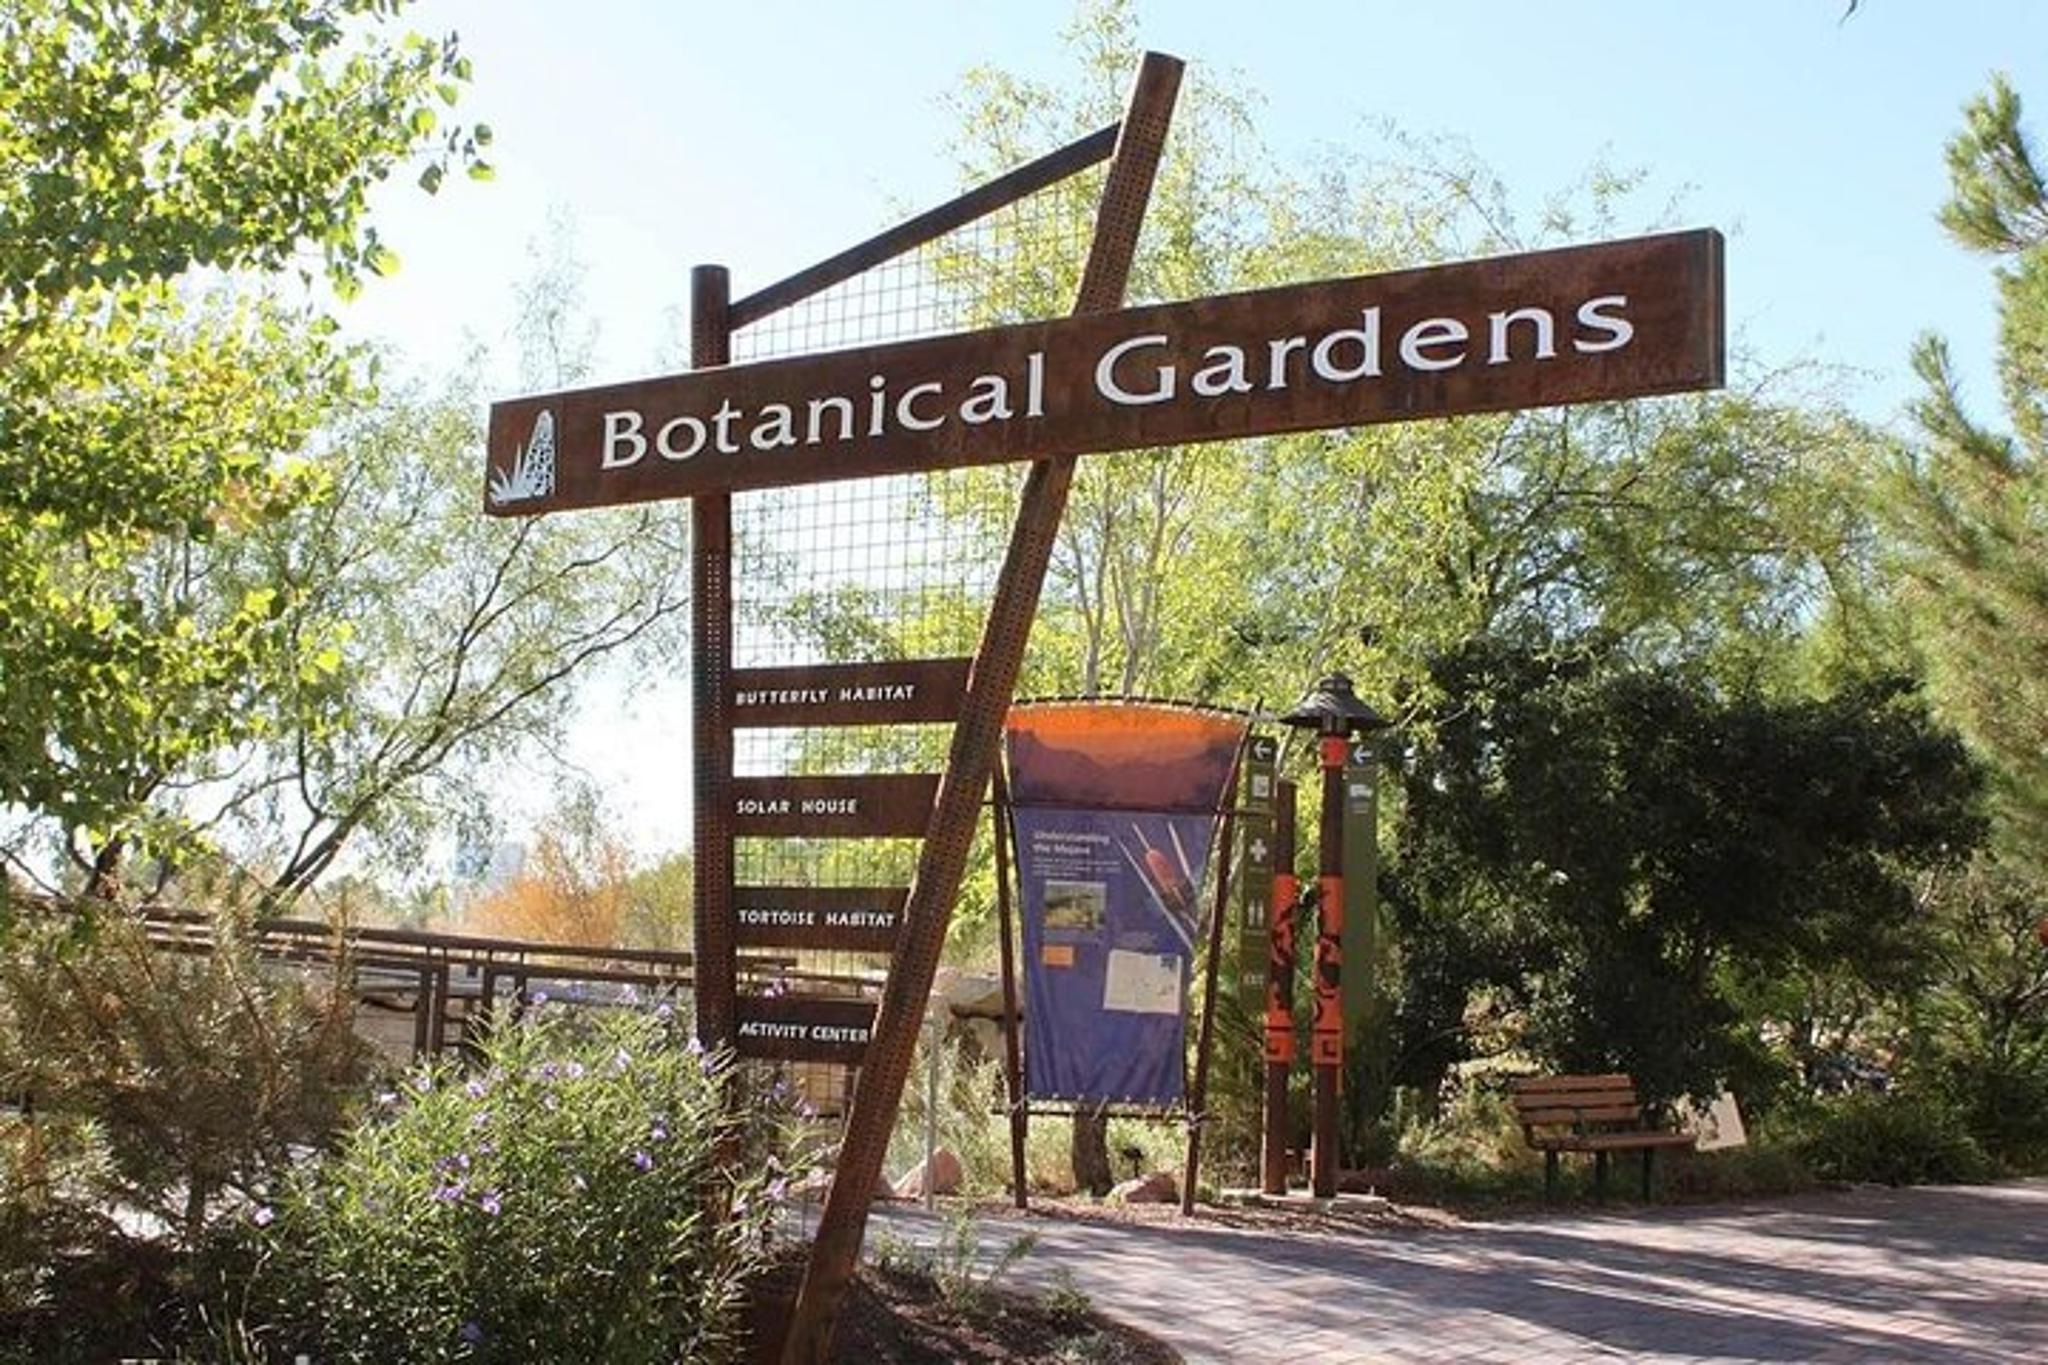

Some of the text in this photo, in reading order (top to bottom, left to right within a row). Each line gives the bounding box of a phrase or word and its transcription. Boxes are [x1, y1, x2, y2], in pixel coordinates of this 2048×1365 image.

[601, 295, 1635, 470] Botanical Gardens
[735, 684, 915, 706] BUTTERFLY HABITAT
[736, 798, 857, 814] SOLAR HOUSE
[738, 909, 895, 928] TORTOISE HABITAT
[739, 1022, 869, 1043] ACTIVITY CENTER
